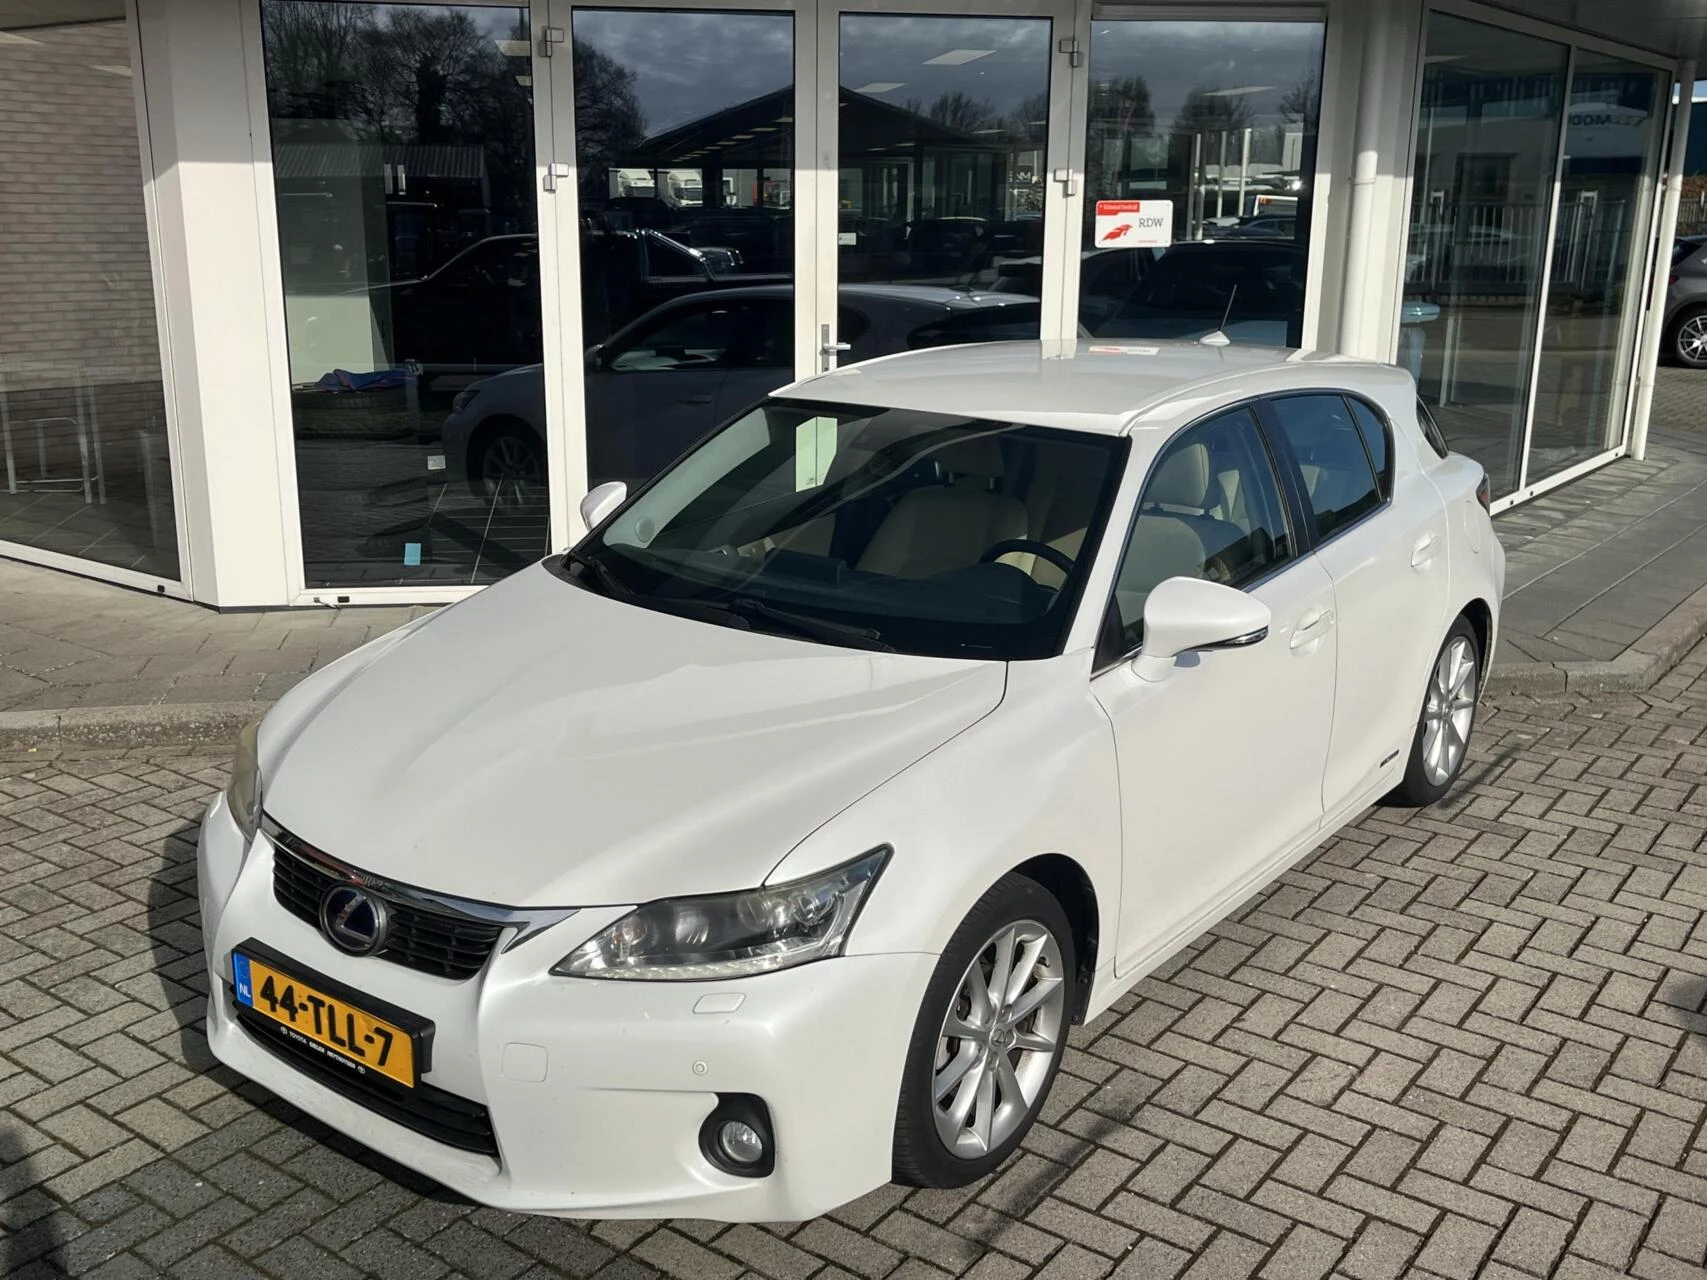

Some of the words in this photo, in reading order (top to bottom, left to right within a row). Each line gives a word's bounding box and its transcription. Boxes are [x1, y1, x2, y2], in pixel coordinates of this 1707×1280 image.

[1138, 217, 1164, 228] RDW
[239, 982, 252, 998] NL
[259, 975, 394, 1067] 44-TLL-7
[288, 1030, 308, 1045] TOYOTA
